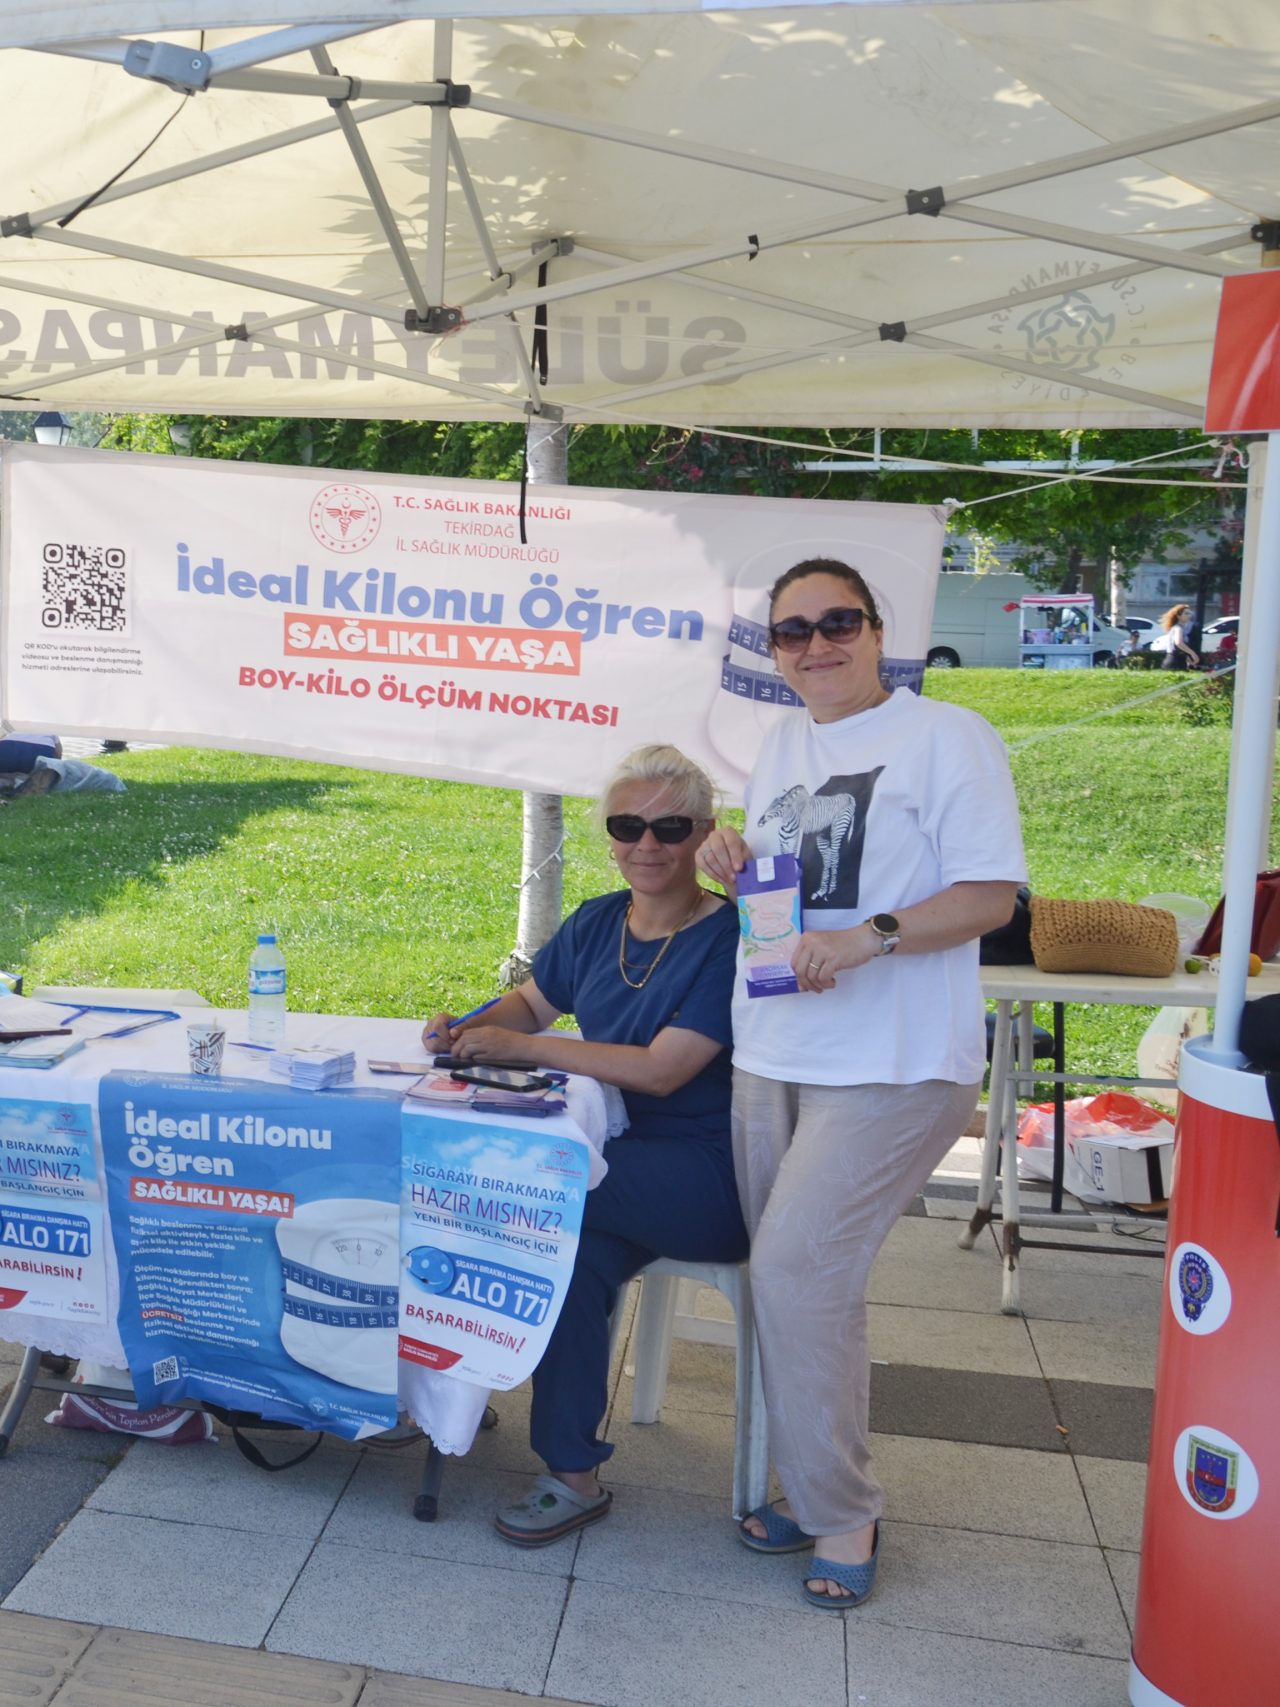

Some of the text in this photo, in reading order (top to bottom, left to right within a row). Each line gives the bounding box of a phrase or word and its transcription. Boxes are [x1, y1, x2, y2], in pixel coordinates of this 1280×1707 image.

[394, 496, 420, 509] T.C.
[424, 498, 480, 514] SAĞLIK
[444, 520, 515, 539] TEKİRDAĞ
[396, 536, 560, 564] İL SAĞLIK MÜDÜRLÜĞÜ
[176, 543, 704, 642] İdeal Kilonu Öğren
[288, 619, 575, 671] SAĞLIKLI YAŞA
[239, 666, 619, 727] BOY-KİLO ÖLÇÜM NOKTASI
[737, 681, 747, 692] 15
[761, 687, 771, 698] 16
[782, 691, 792, 701] 17
[124, 1101, 332, 1150] İdeal Kilonu
[6, 1140, 80, 1157] BIRAKMAYA
[128, 1137, 235, 1177] Öğren
[7, 1156, 81, 1182] MISINIZ?
[413, 1162, 566, 1203] SİGARAYI BIRAKMAYA
[1, 1180, 60, 1195] BAŞLANGIÇ
[63, 1187, 84, 1197] İÇİN
[134, 1180, 290, 1215] SAĞLIKLI YAŞA!
[72, 1219, 88, 1228] HATTI
[411, 1184, 563, 1235] HAZIR MISINIZ?
[2, 1222, 89, 1254] ALO 171
[414, 1211, 558, 1255] YENİ BİR BAŞLANGIÇ İÇİN
[456, 1260, 478, 1271] SİGARA
[479, 1265, 506, 1279] BIRAKMA
[535, 1281, 553, 1293] HATTI
[342, 1290, 352, 1298] 38
[365, 1294, 375, 1303] 39
[451, 1273, 549, 1323] ALO 171
[349, 1317, 357, 1325] 18
